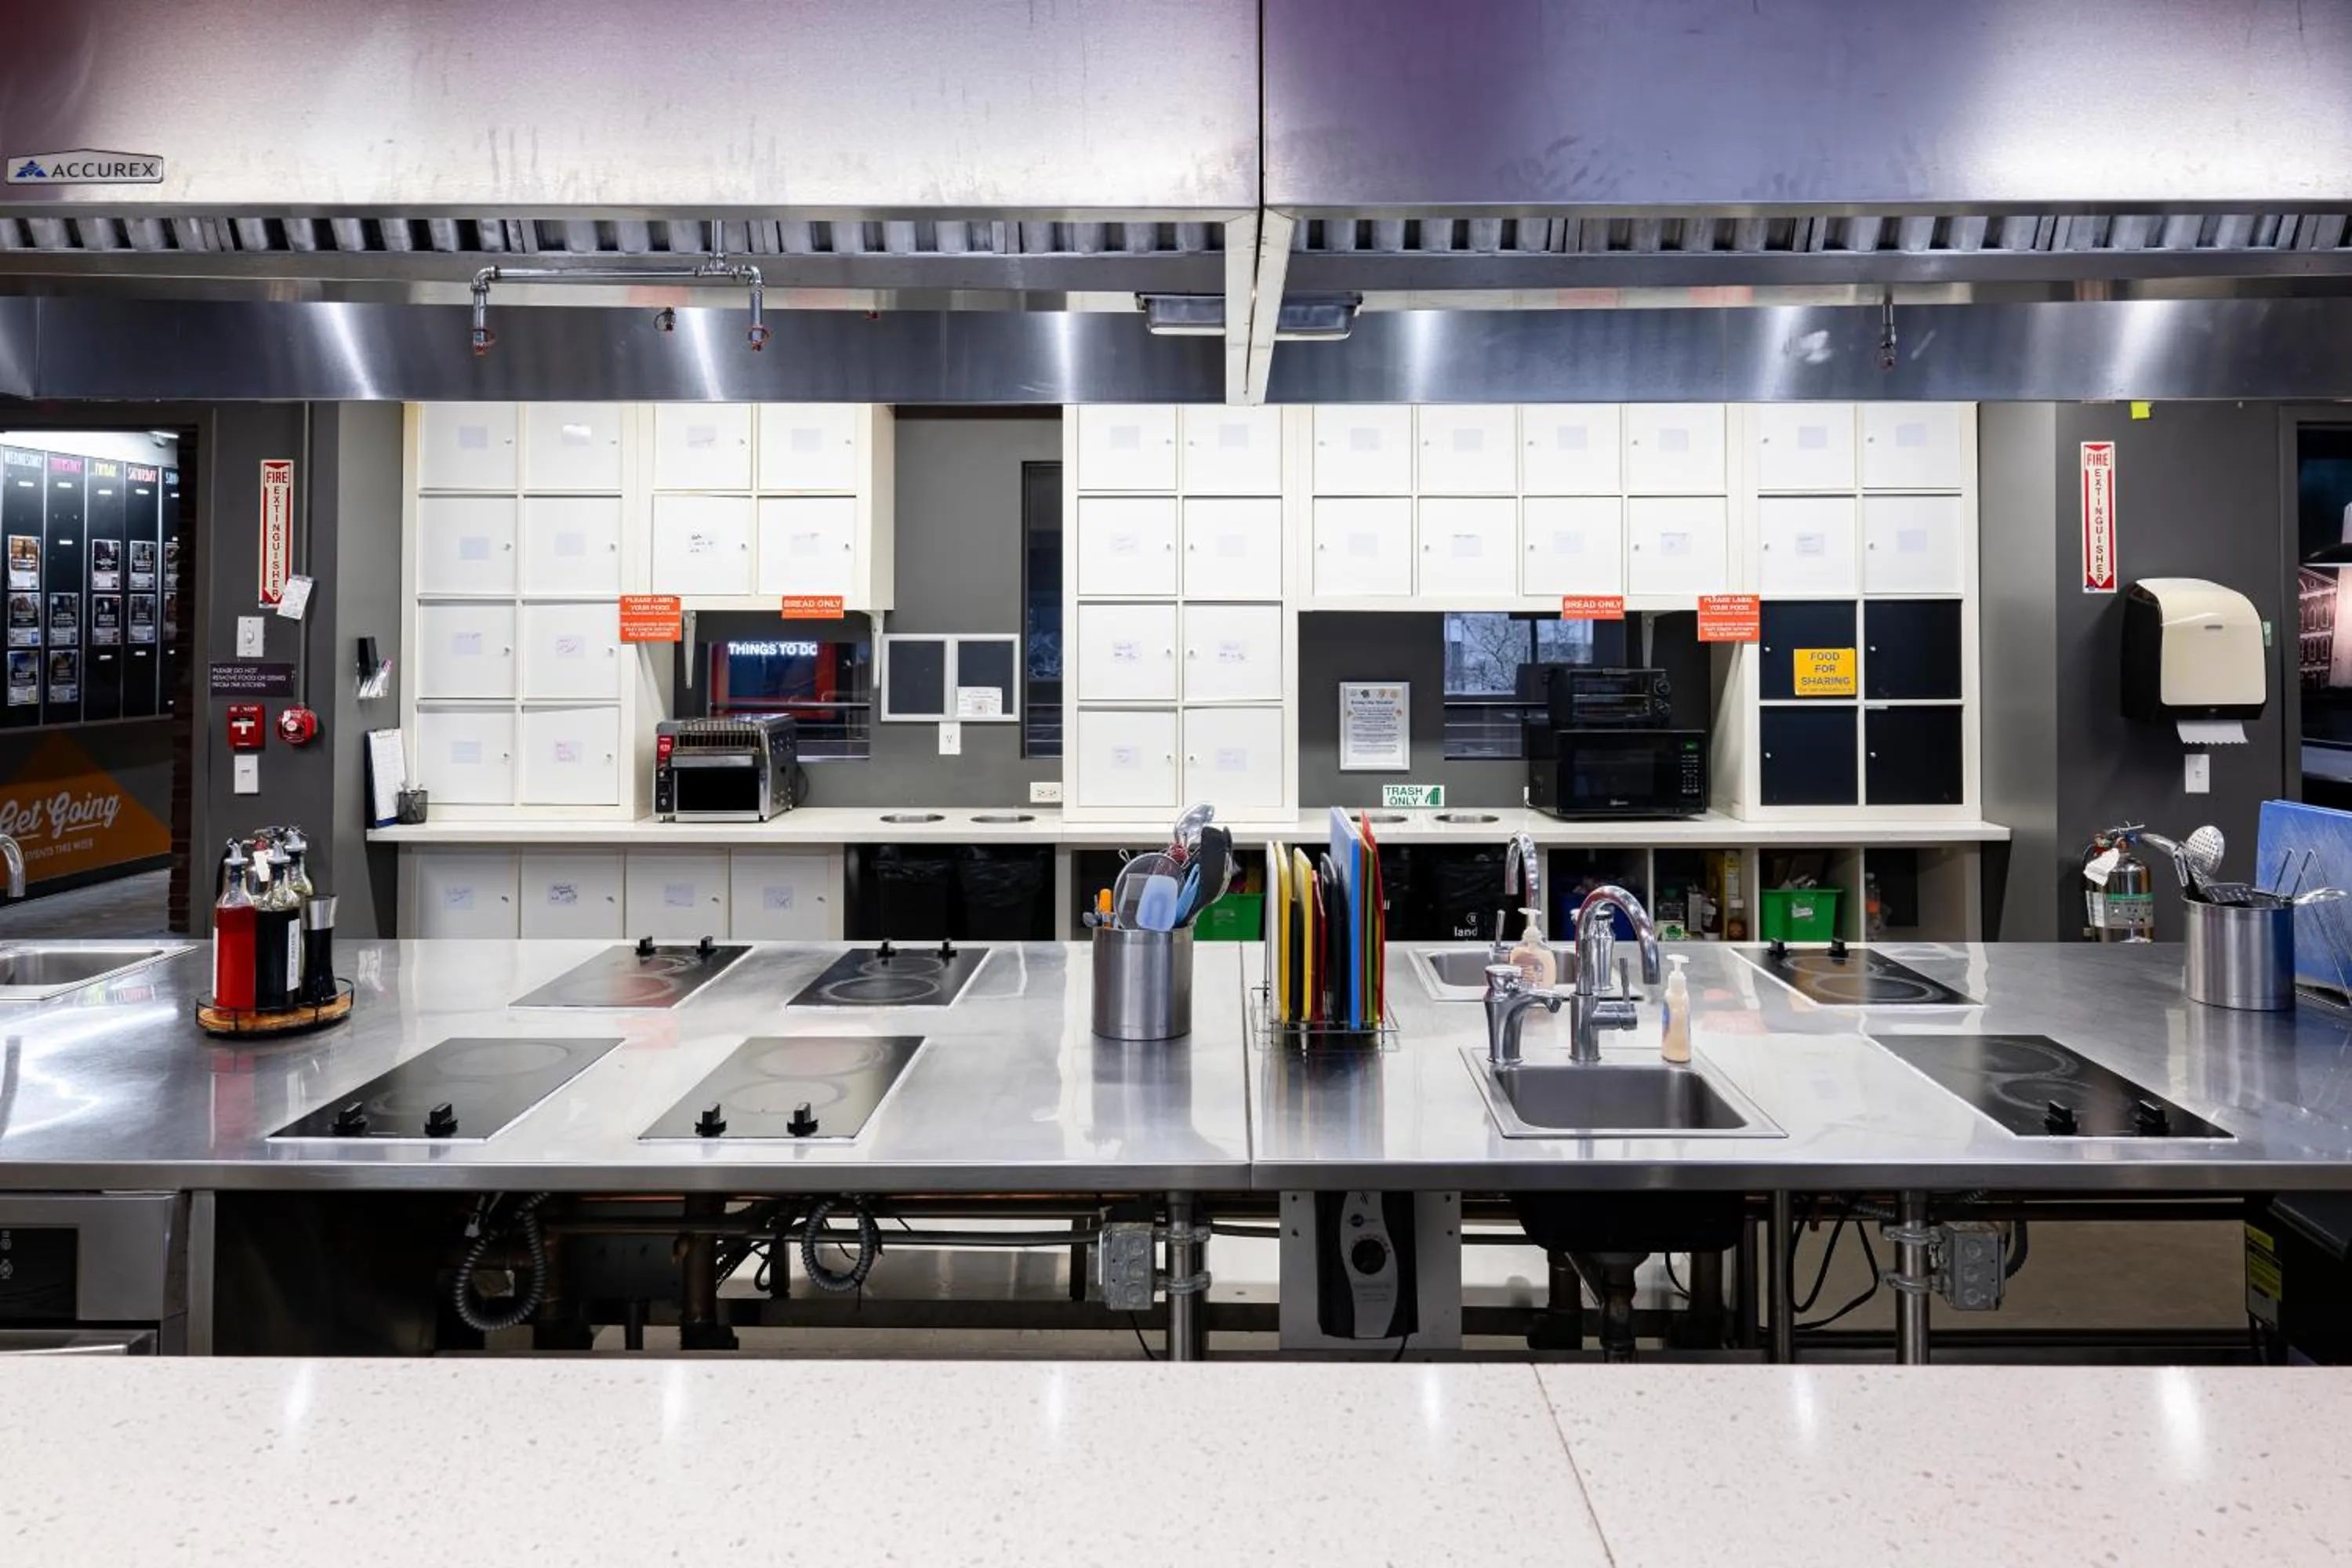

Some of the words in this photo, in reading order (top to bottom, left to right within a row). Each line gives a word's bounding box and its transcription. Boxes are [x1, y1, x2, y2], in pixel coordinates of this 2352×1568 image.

[52, 162, 154, 178] ACCUREX
[2086, 452, 2109, 466] FIRE
[266, 471, 289, 484] FIRE
[2094, 468, 2103, 582] EXTINGUISHER
[272, 485, 281, 597] EXTINGUISHER
[784, 599, 815, 608] BREAD
[817, 599, 841, 608] ONLY
[1565, 600, 1595, 608] BREAD
[1597, 600, 1622, 608] ONLY
[728, 641, 777, 655] THINGS
[779, 641, 797, 655] TO
[1810, 652, 1840, 661] FOOD
[1814, 664, 1836, 673] FOR
[1801, 677, 1850, 685] SHARING
[1385, 786, 1423, 796] TRASH
[1389, 797, 1417, 805] ONLY
[0, 800, 43, 834] Get
[46, 791, 122, 839] Going
